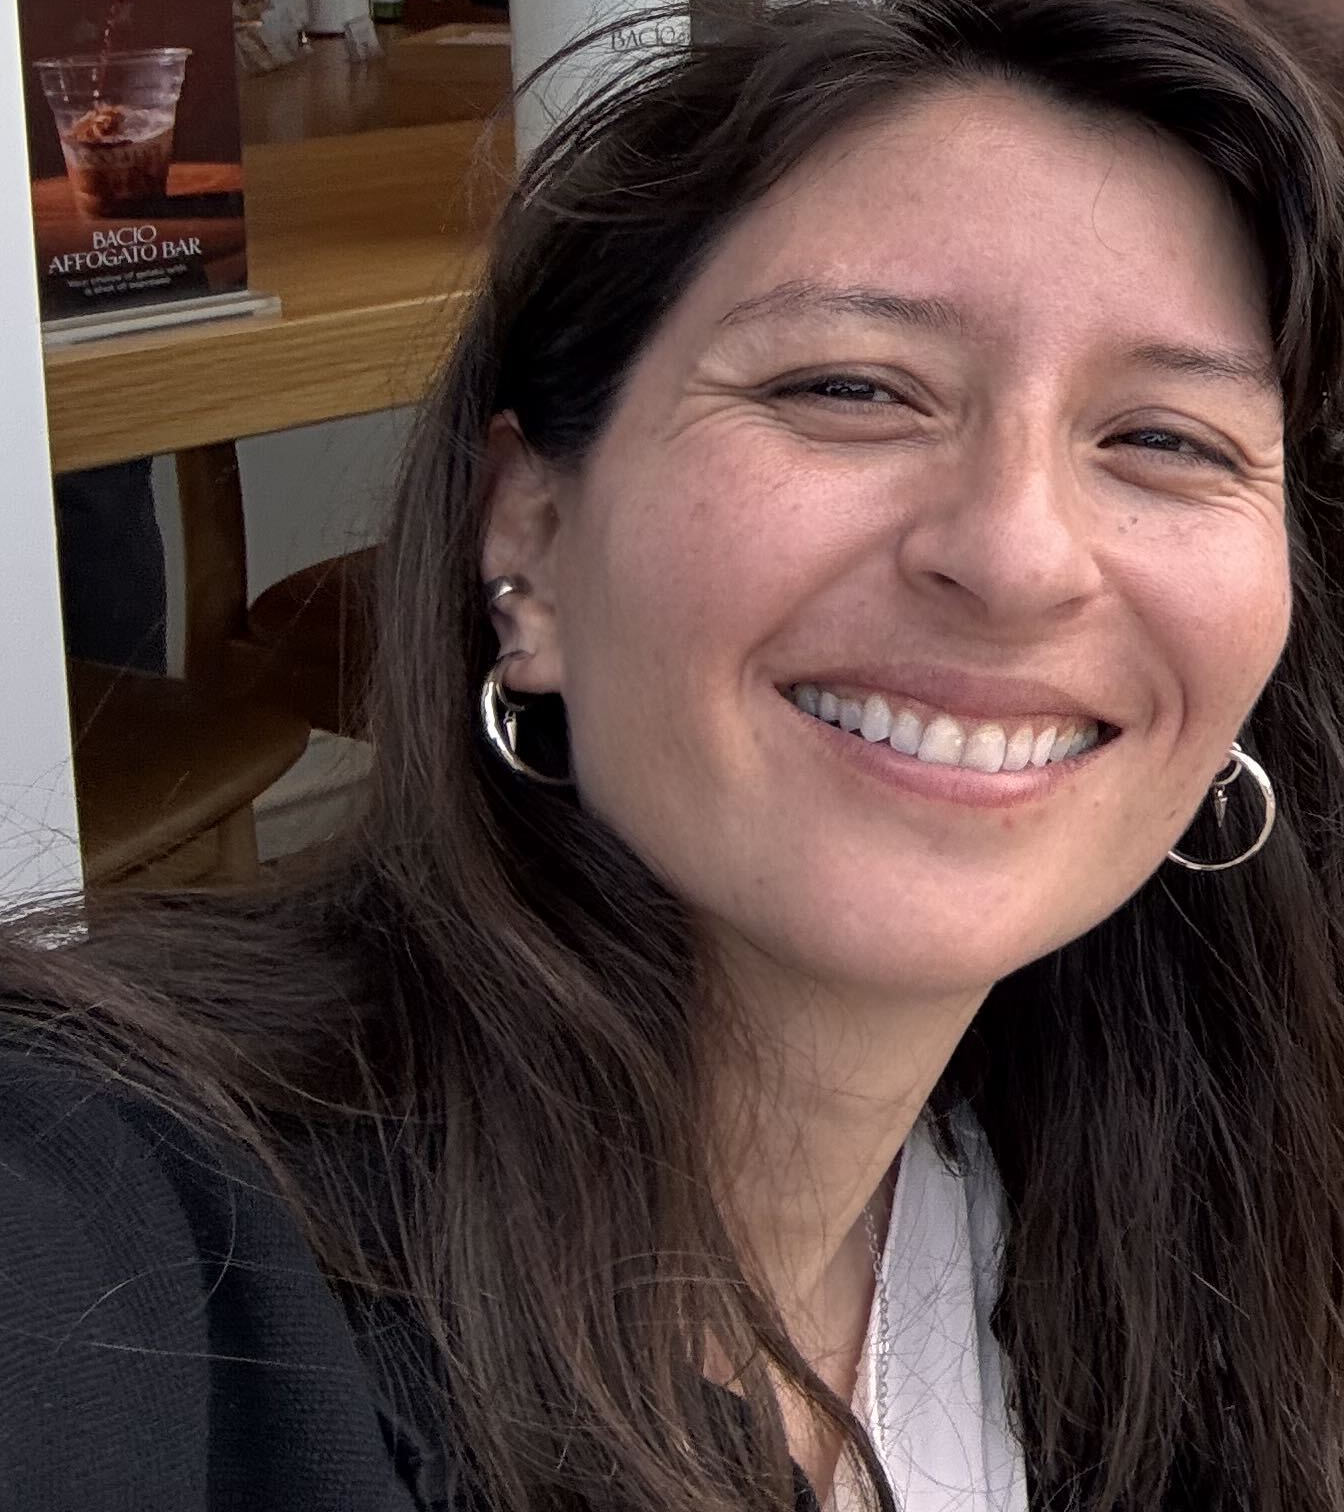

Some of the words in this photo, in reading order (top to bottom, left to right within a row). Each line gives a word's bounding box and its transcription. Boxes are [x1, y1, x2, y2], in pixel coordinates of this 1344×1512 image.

[92, 225, 158, 250] BACIO
[48, 244, 158, 274] AFFOGATO
[162, 237, 202, 259] BAR
